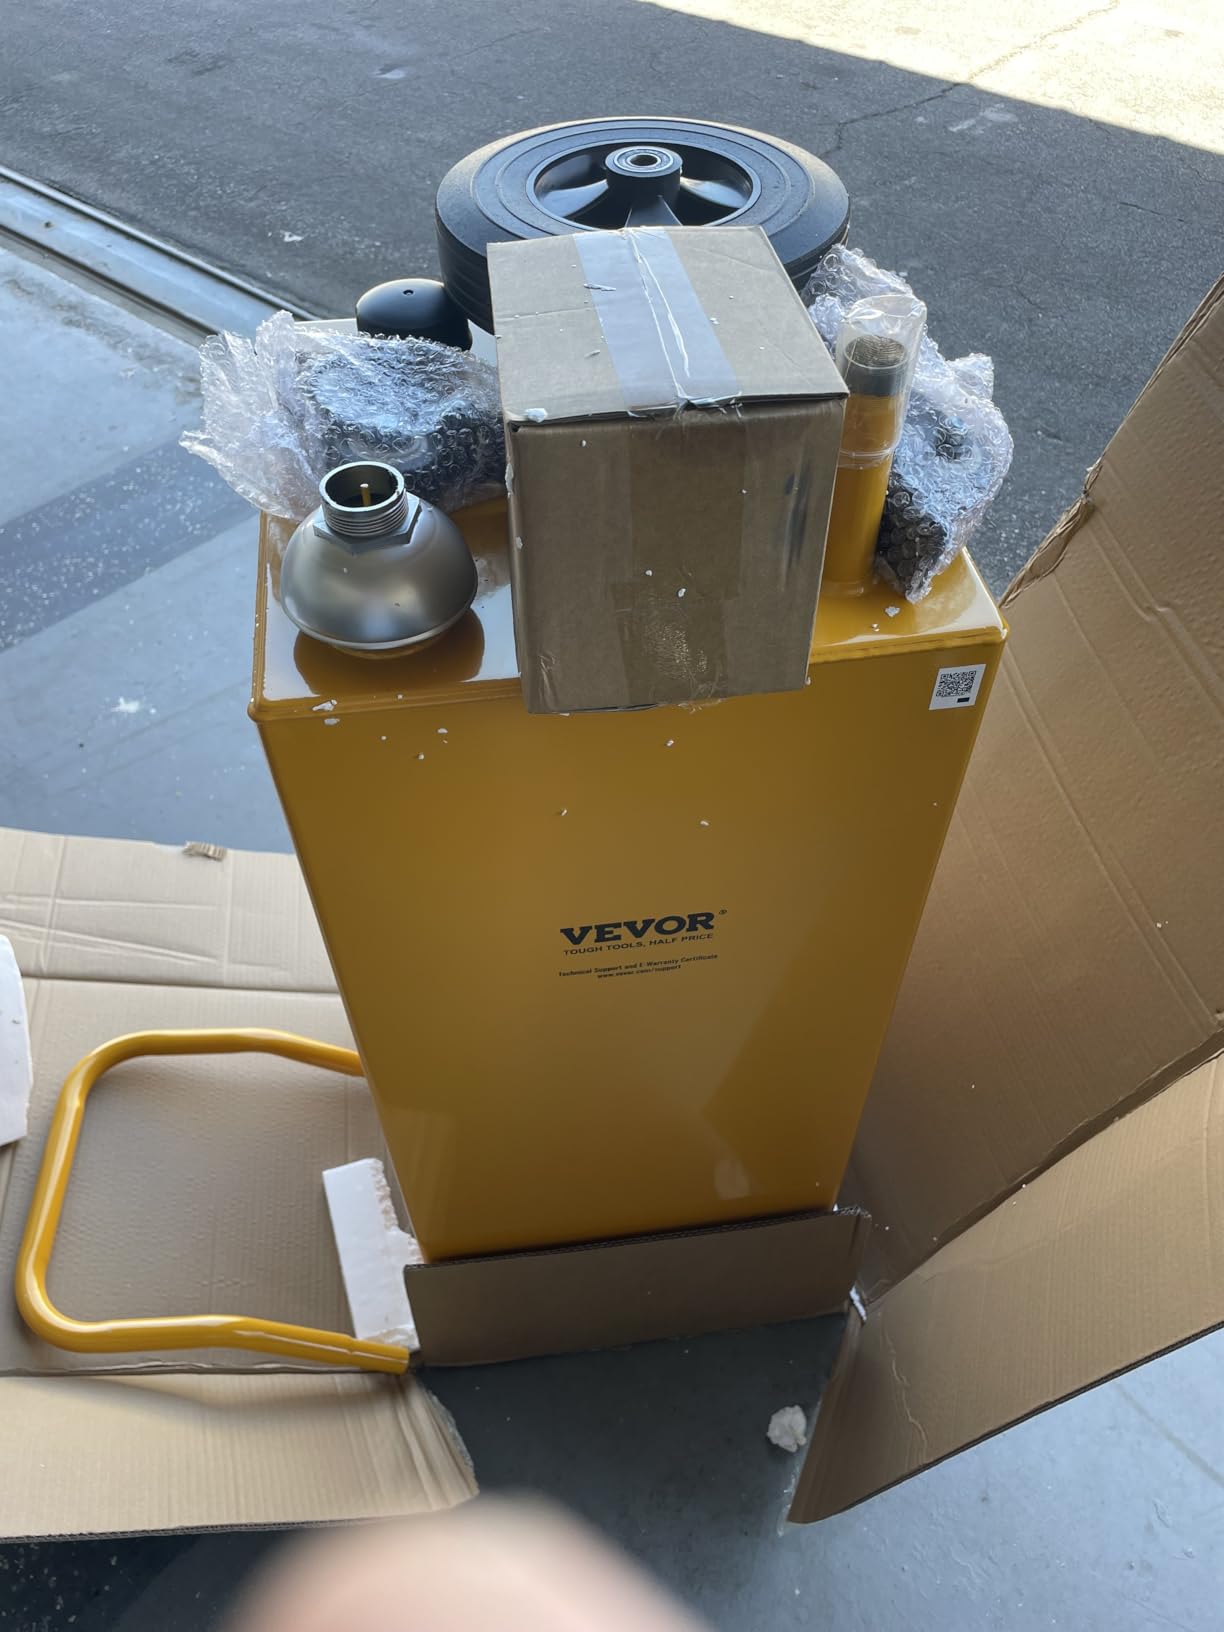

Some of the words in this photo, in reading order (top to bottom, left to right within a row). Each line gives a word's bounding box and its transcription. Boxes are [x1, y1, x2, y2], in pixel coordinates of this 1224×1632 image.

[560, 912, 715, 945] VEVOR
[564, 946, 603, 956] TOUGH
[607, 941, 646, 951] TOOLS,
[649, 938, 678, 946] HALF
[681, 933, 714, 942] PRICE
[559, 967, 592, 977] Technical
[594, 965, 622, 974] Support
